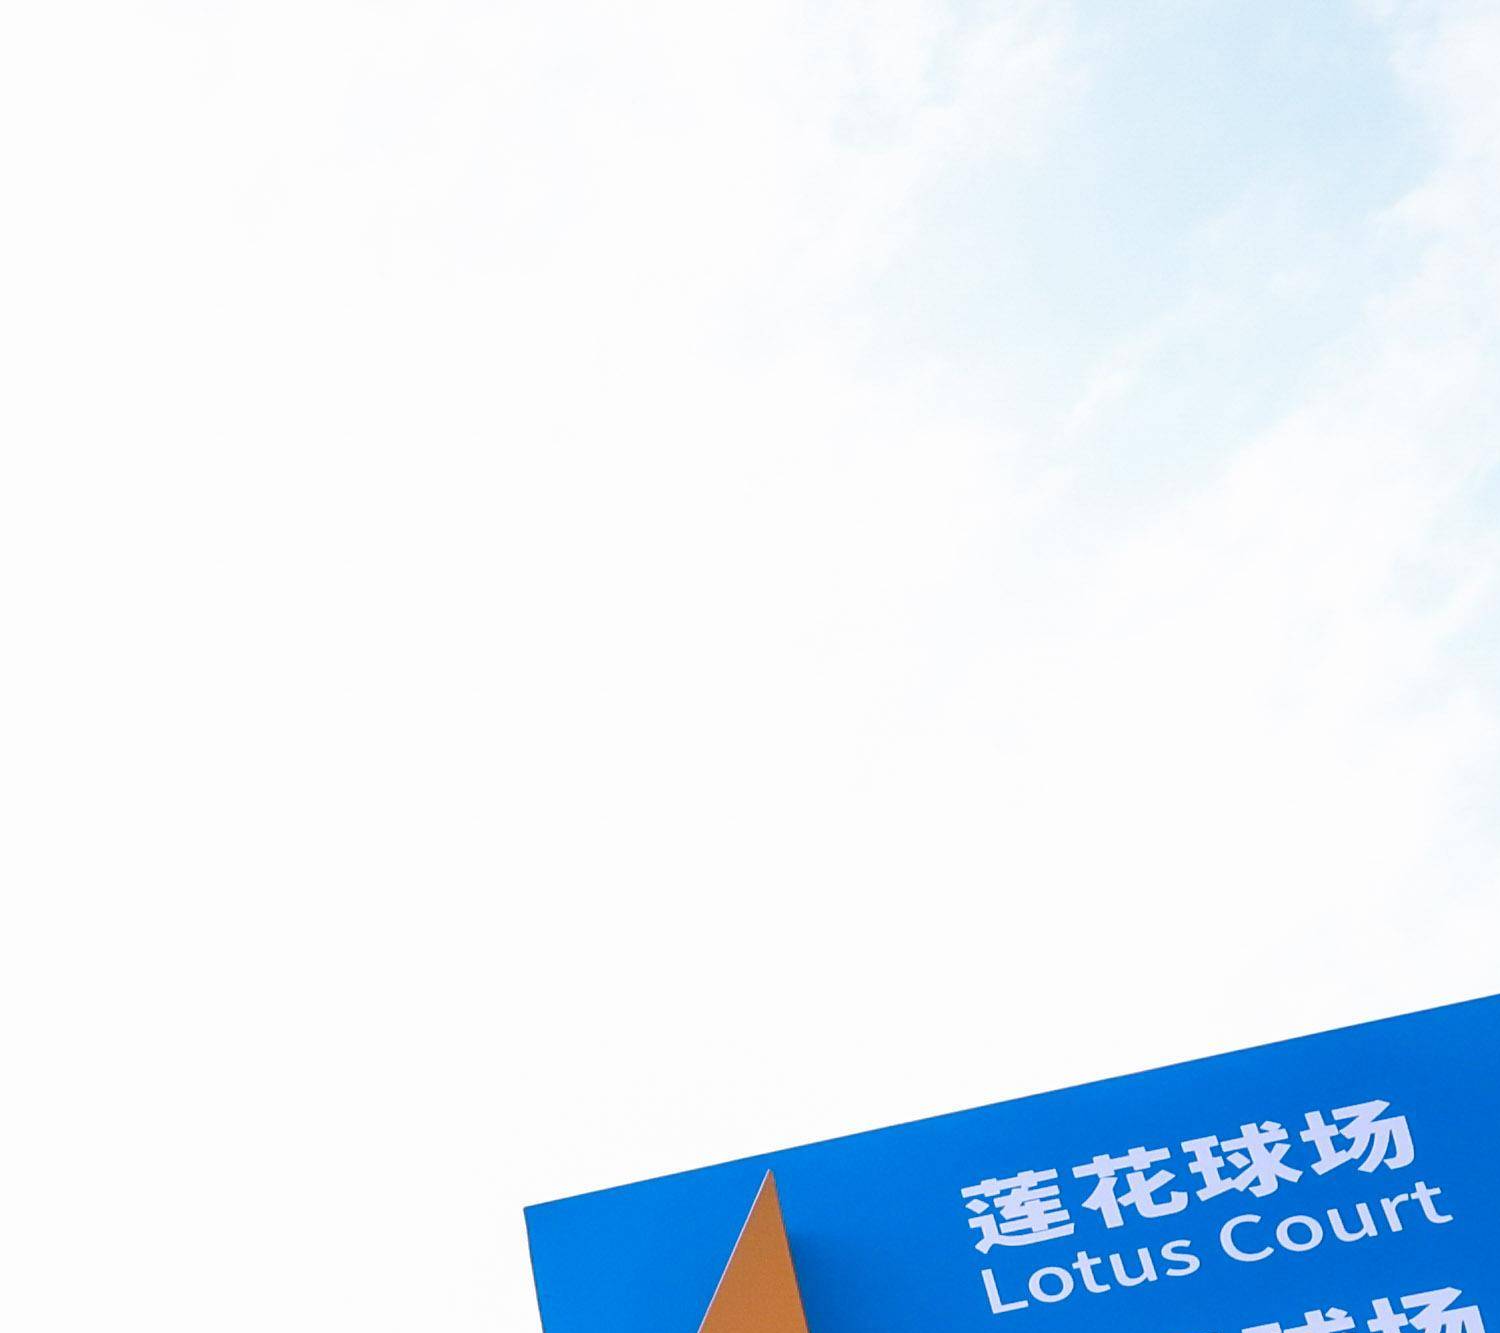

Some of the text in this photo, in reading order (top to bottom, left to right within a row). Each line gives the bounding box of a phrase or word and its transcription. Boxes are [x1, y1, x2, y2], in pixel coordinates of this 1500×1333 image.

[961, 1100, 1415, 1254] 莲花球场
[982, 1182, 1453, 1314] Lotus Court
